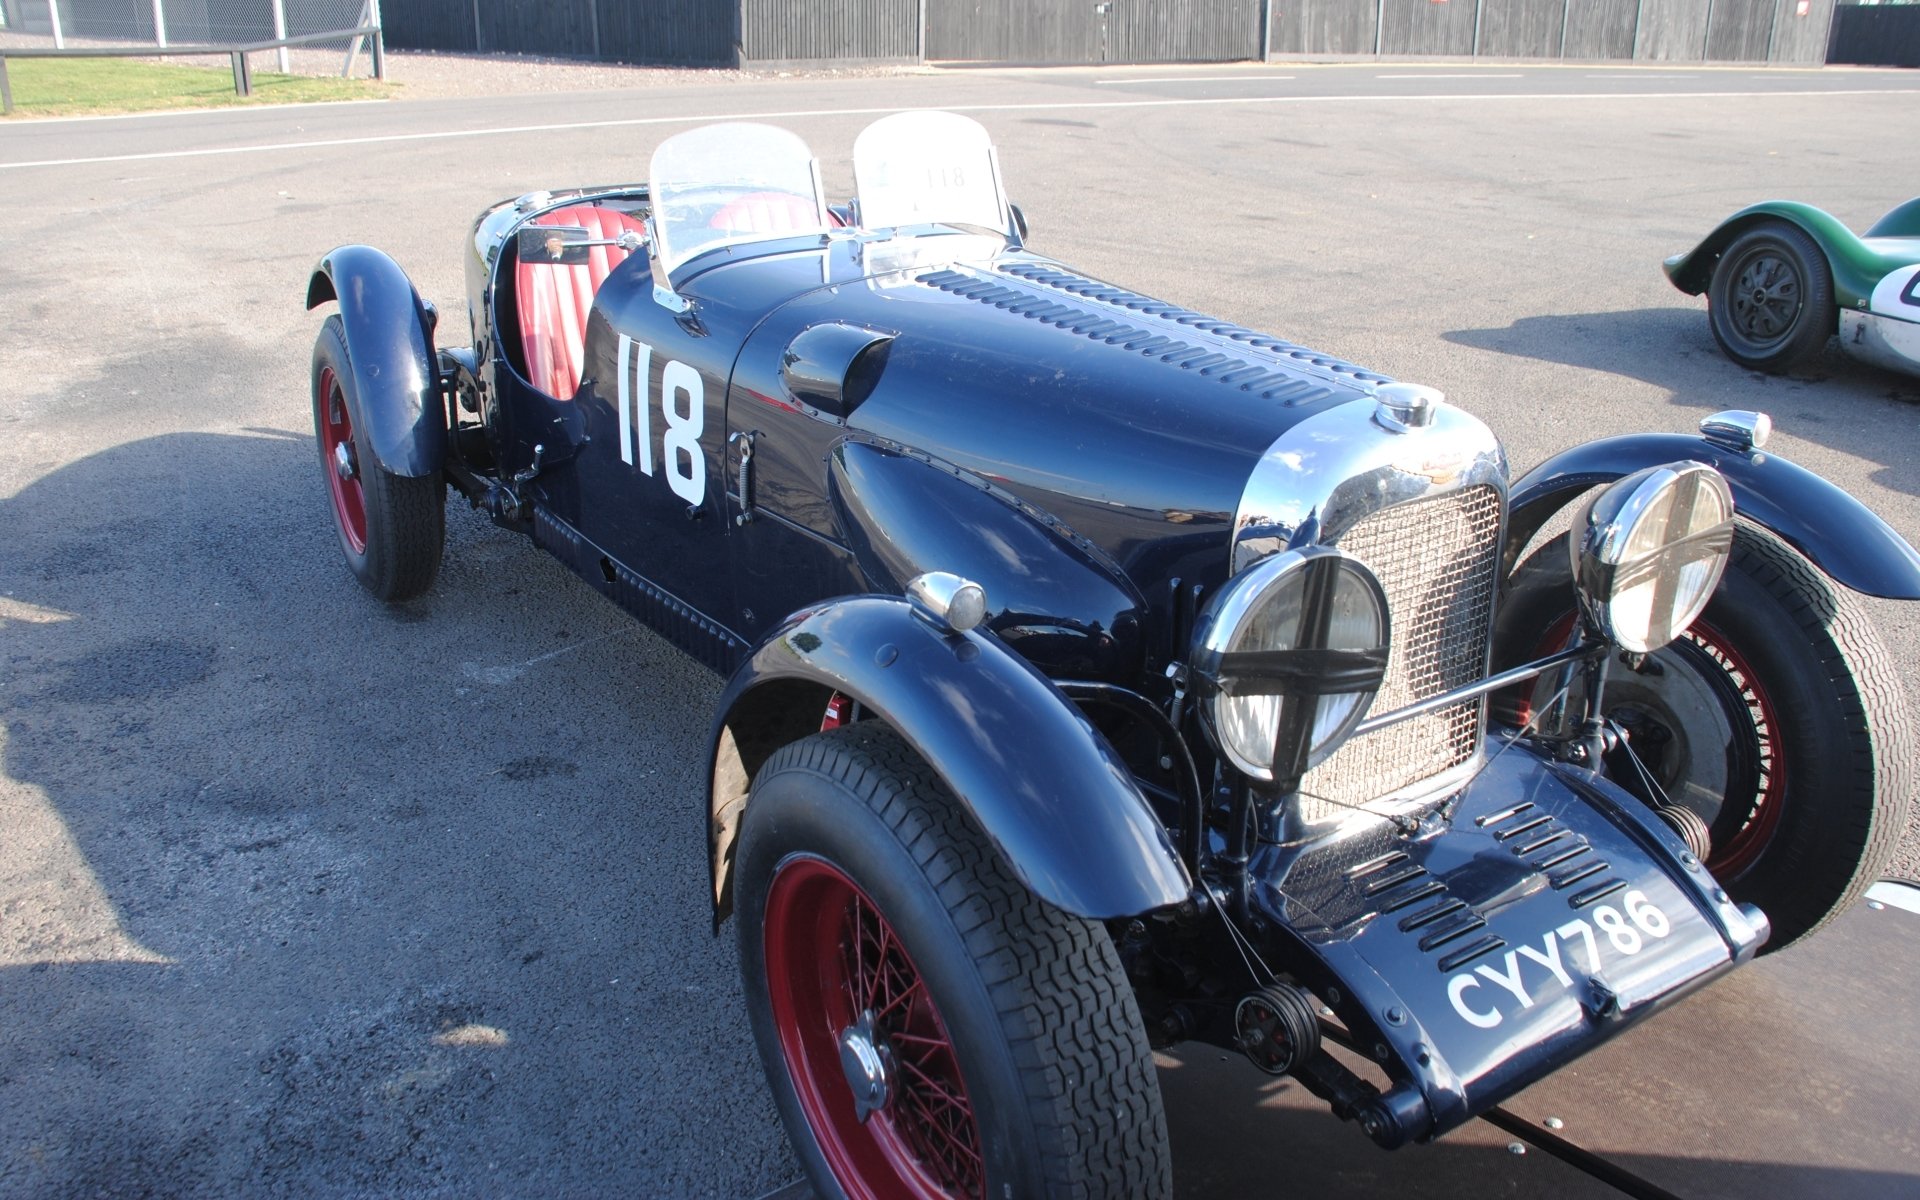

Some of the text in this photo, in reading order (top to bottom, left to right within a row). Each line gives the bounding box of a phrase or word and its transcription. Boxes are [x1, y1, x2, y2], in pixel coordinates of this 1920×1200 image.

[926, 166, 965, 189] 118
[617, 332, 706, 507] 118
[1447, 890, 1670, 1028] CYY786
